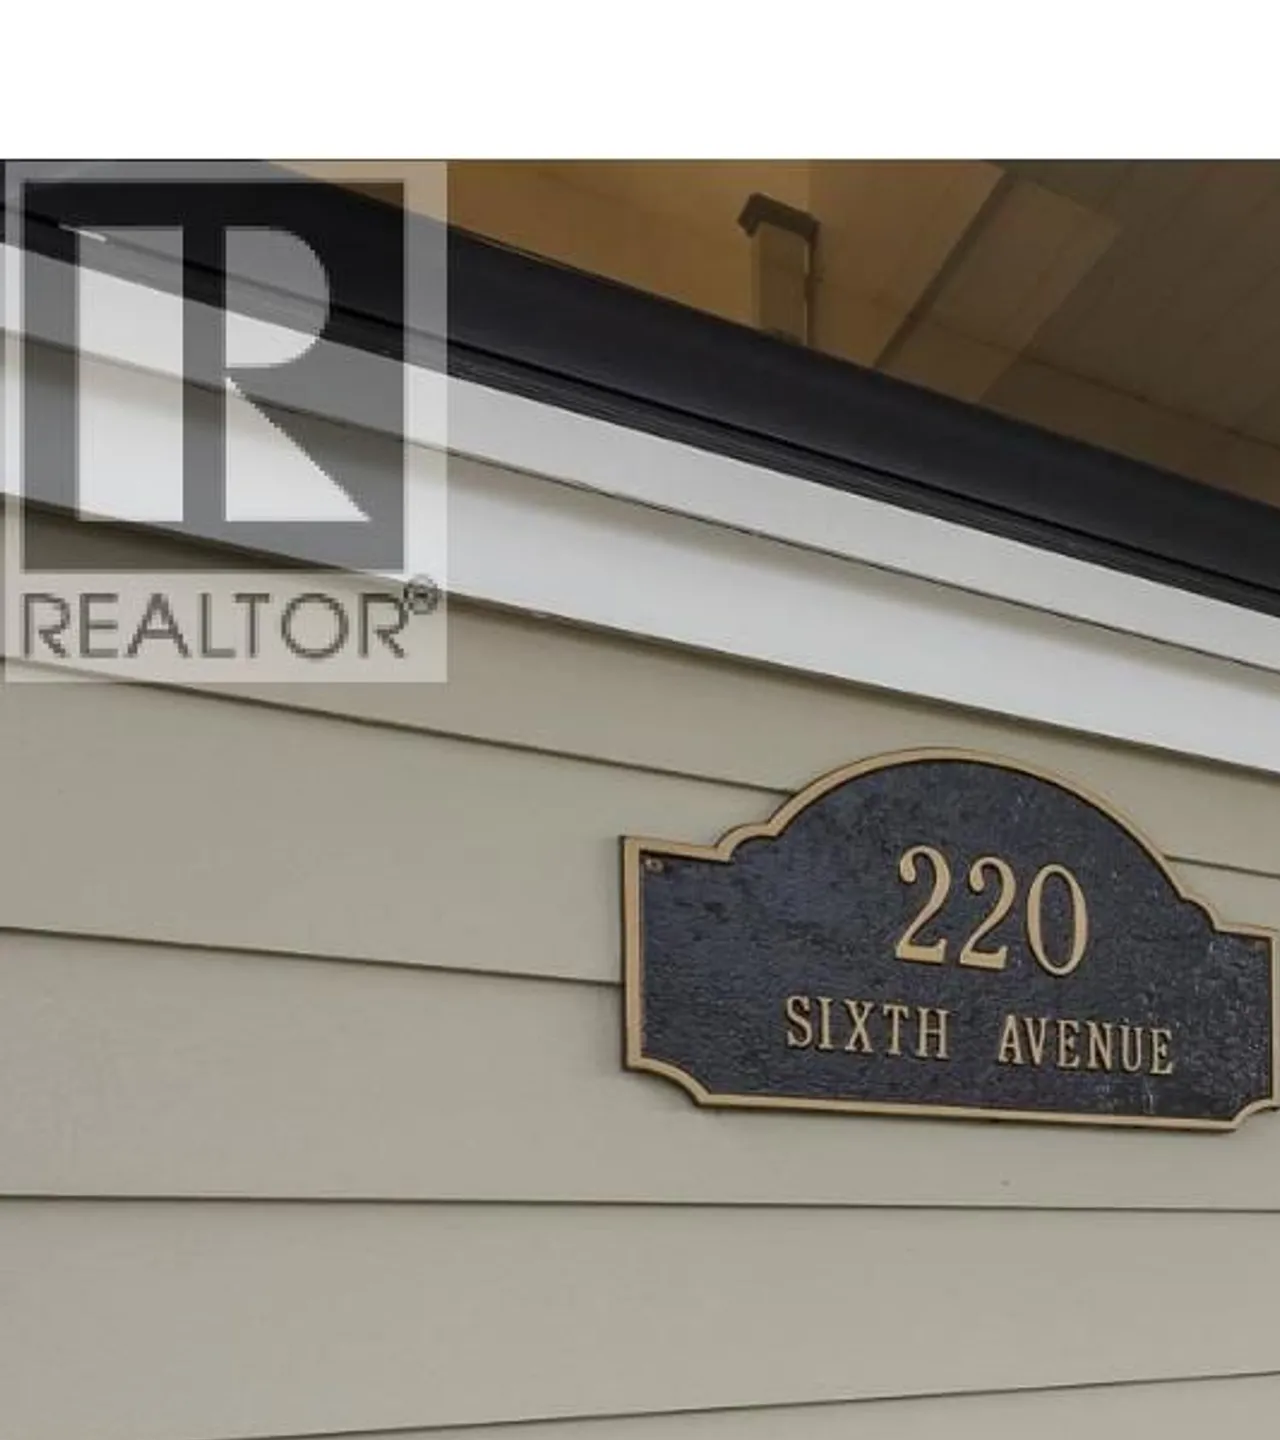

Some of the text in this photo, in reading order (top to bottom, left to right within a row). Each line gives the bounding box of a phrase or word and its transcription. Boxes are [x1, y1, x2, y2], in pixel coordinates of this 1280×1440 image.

[895, 845, 1088, 977] 220
[786, 996, 1173, 1075] SIXTH AVENUE
